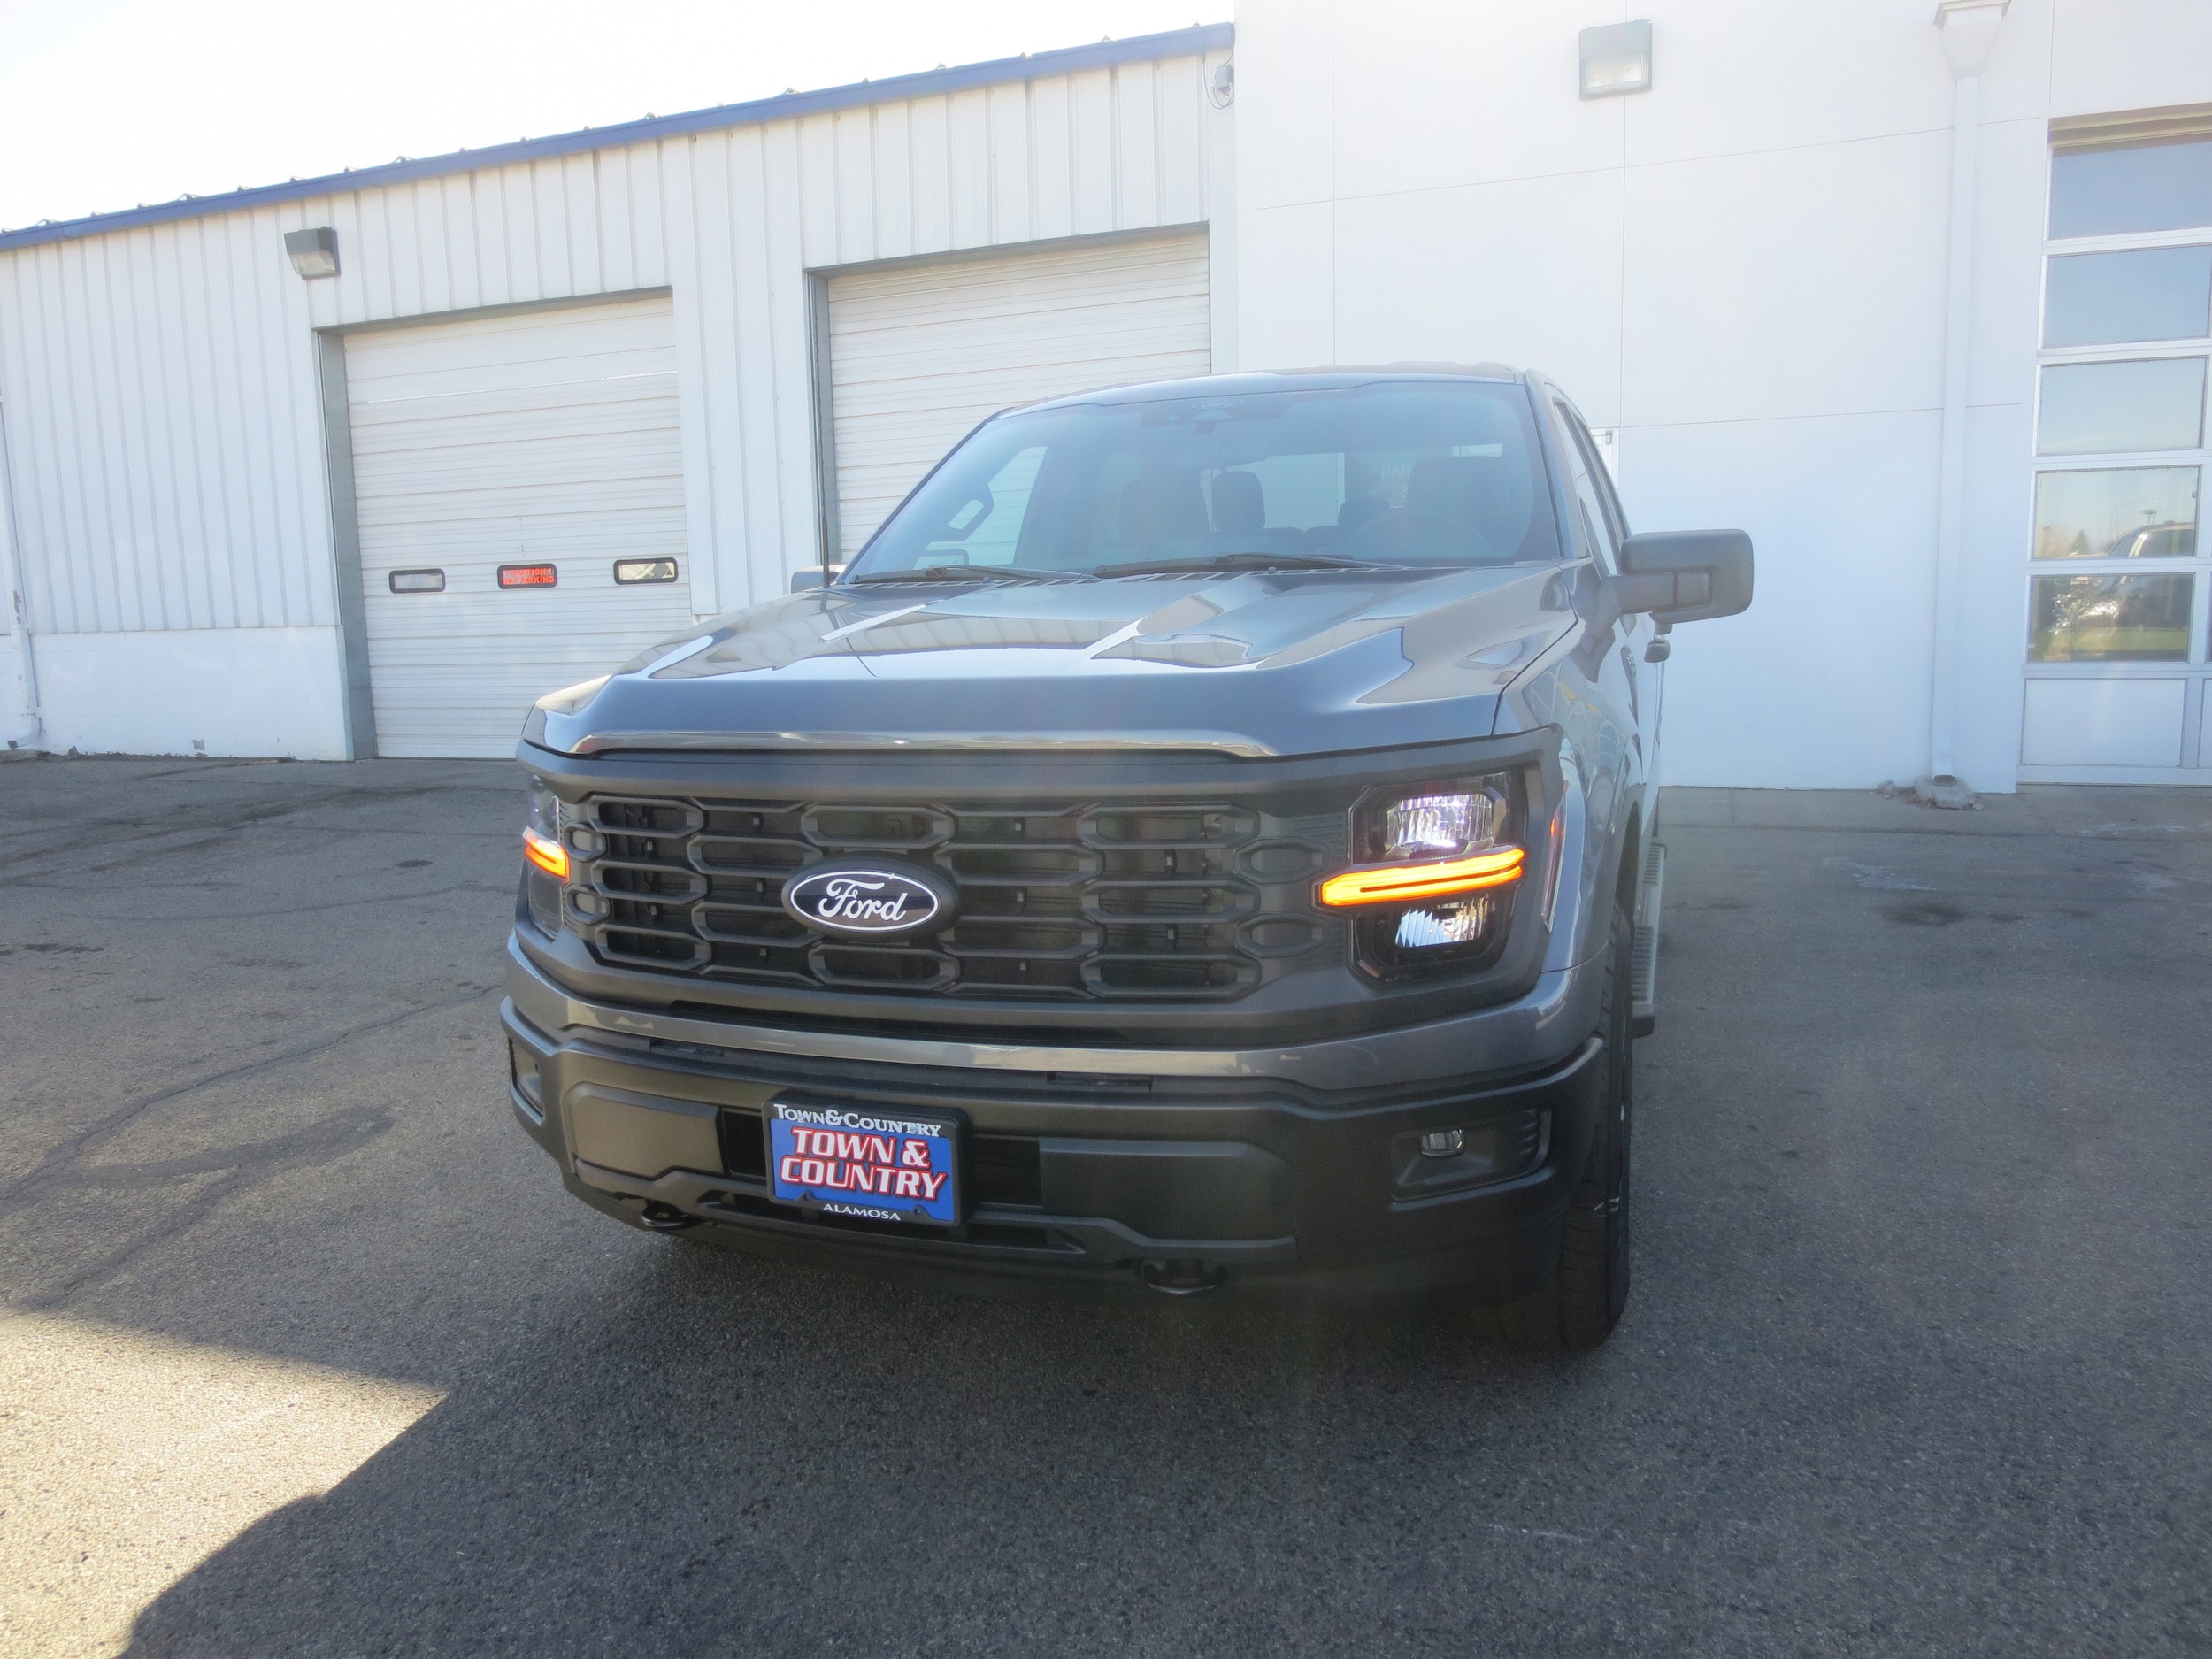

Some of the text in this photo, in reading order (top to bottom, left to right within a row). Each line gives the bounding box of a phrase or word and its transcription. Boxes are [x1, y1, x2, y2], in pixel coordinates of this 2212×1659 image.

[509, 568, 547, 577] CAUTION
[818, 879, 908, 921] Ford
[791, 1127, 931, 1169] TOWN &
[780, 1155, 947, 1201] COUNTRY
[823, 1203, 901, 1221] ALAMOSA
